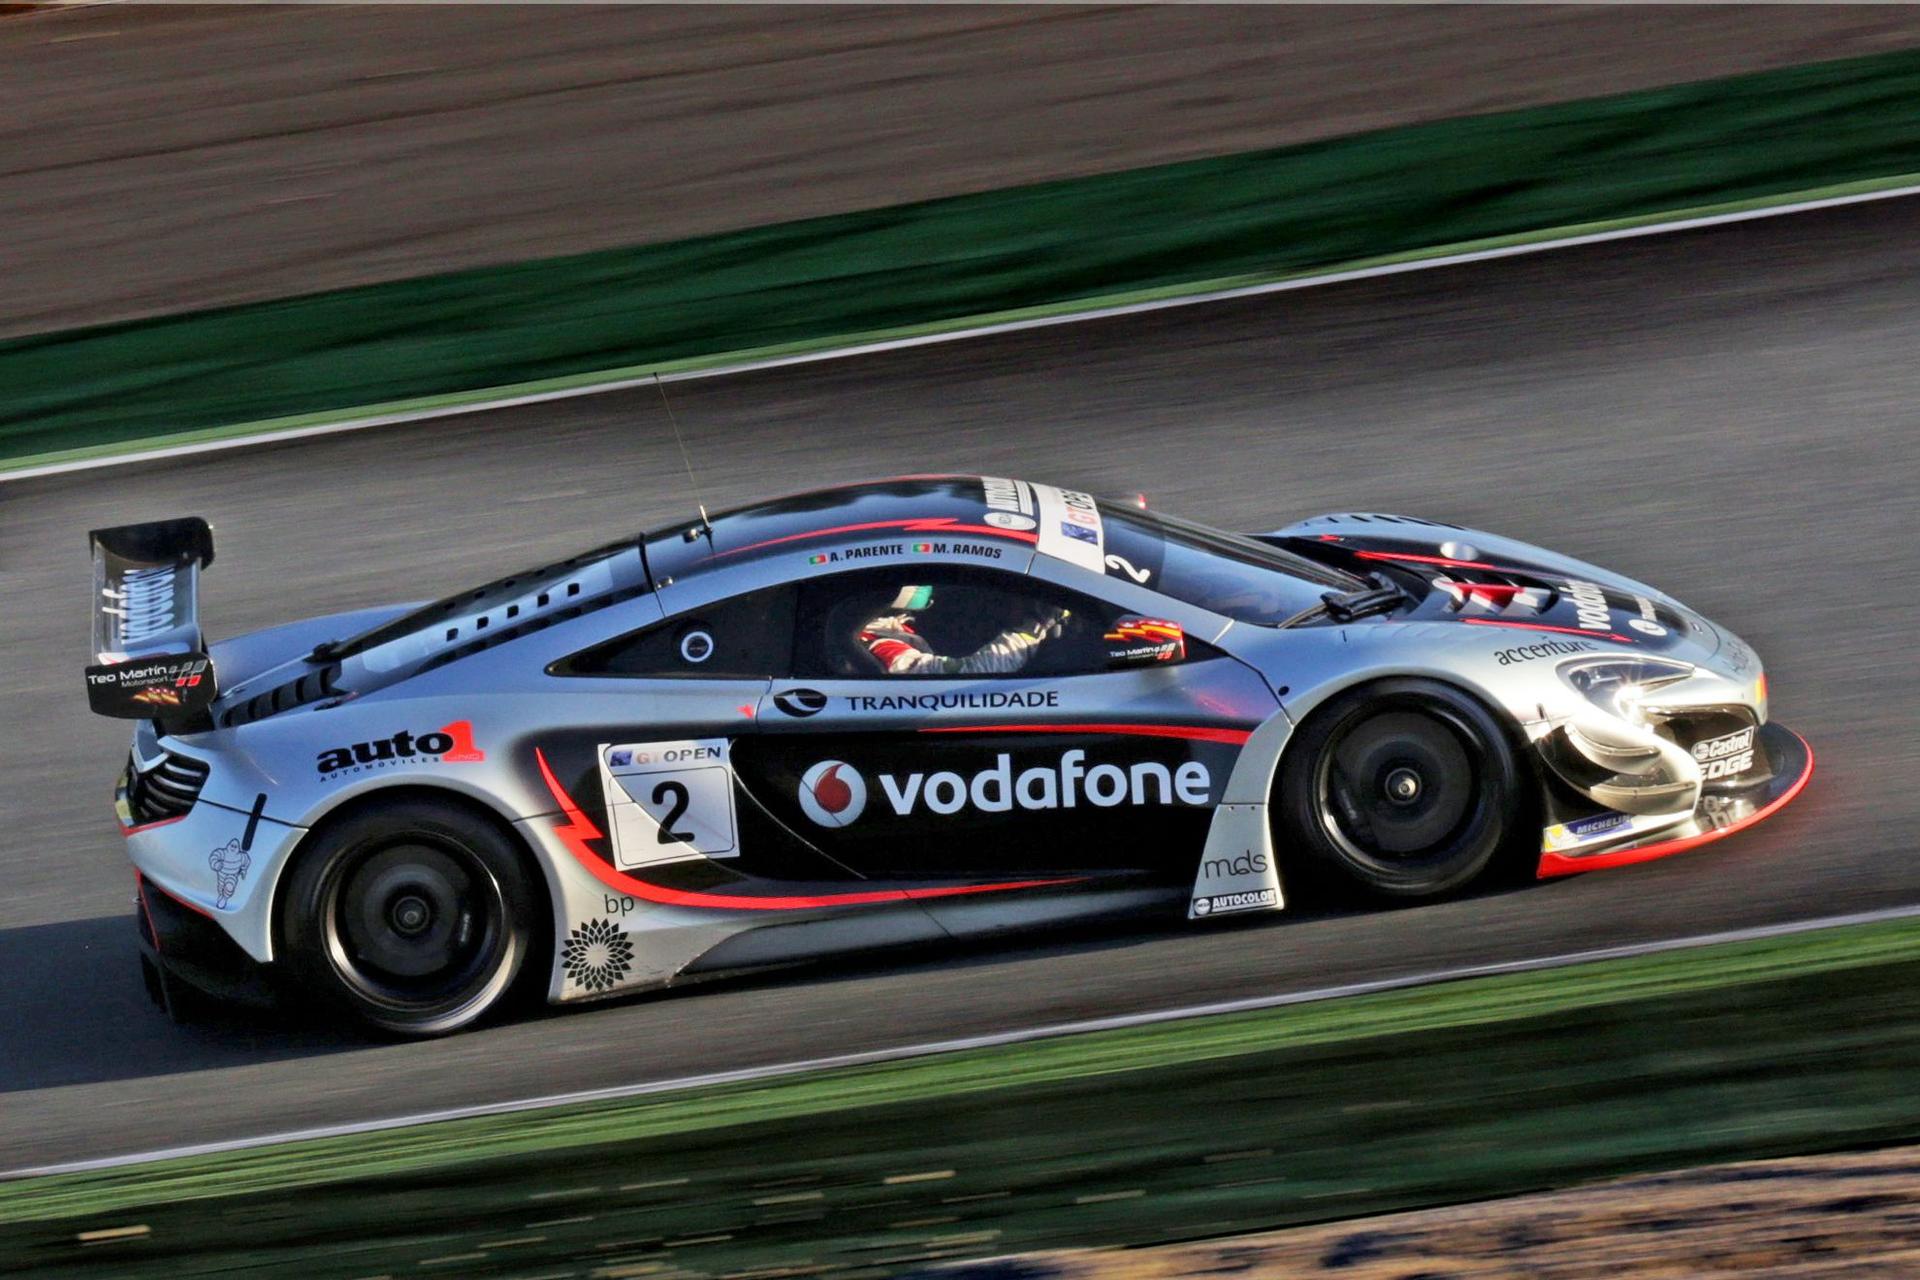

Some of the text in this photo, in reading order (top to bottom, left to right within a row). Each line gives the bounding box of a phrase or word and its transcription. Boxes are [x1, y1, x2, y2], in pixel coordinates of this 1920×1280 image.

[829, 543, 904, 563] A. PARENTE
[933, 542, 1003, 560] M. RAMOS
[1104, 553, 1151, 584] 2
[1494, 637, 1599, 666] accenture
[88, 673, 116, 686] Teo
[121, 676, 169, 688] Motorsport
[845, 690, 1059, 712] TRANQUILIDADE
[663, 746, 722, 763] OPEN
[1709, 731, 1750, 757] Castrol
[320, 757, 440, 783] AUTOMOVILES
[1697, 749, 1755, 782] EDGE
[877, 748, 1211, 816] vodafone
[651, 780, 696, 845] 2
[1575, 814, 1633, 835] MICHELIN
[1204, 848, 1268, 879] mds
[603, 893, 635, 918] bp
[1211, 889, 1276, 909] AUTOCOLOR
